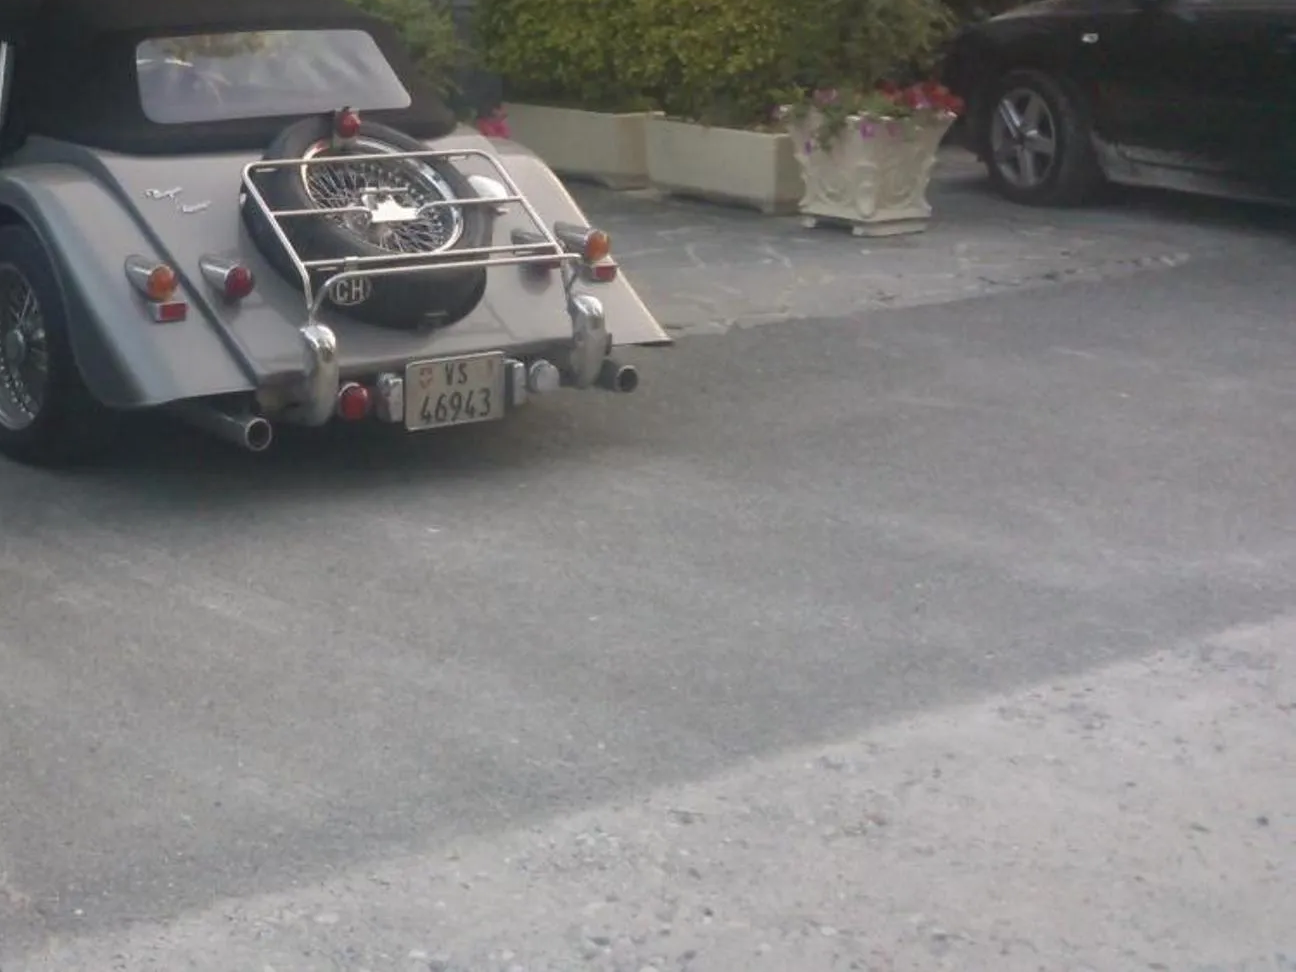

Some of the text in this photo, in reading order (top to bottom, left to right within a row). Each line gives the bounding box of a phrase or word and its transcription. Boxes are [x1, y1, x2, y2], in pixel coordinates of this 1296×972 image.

[336, 279, 364, 301] CH
[445, 362, 468, 385] VS
[420, 388, 491, 423] 46943
